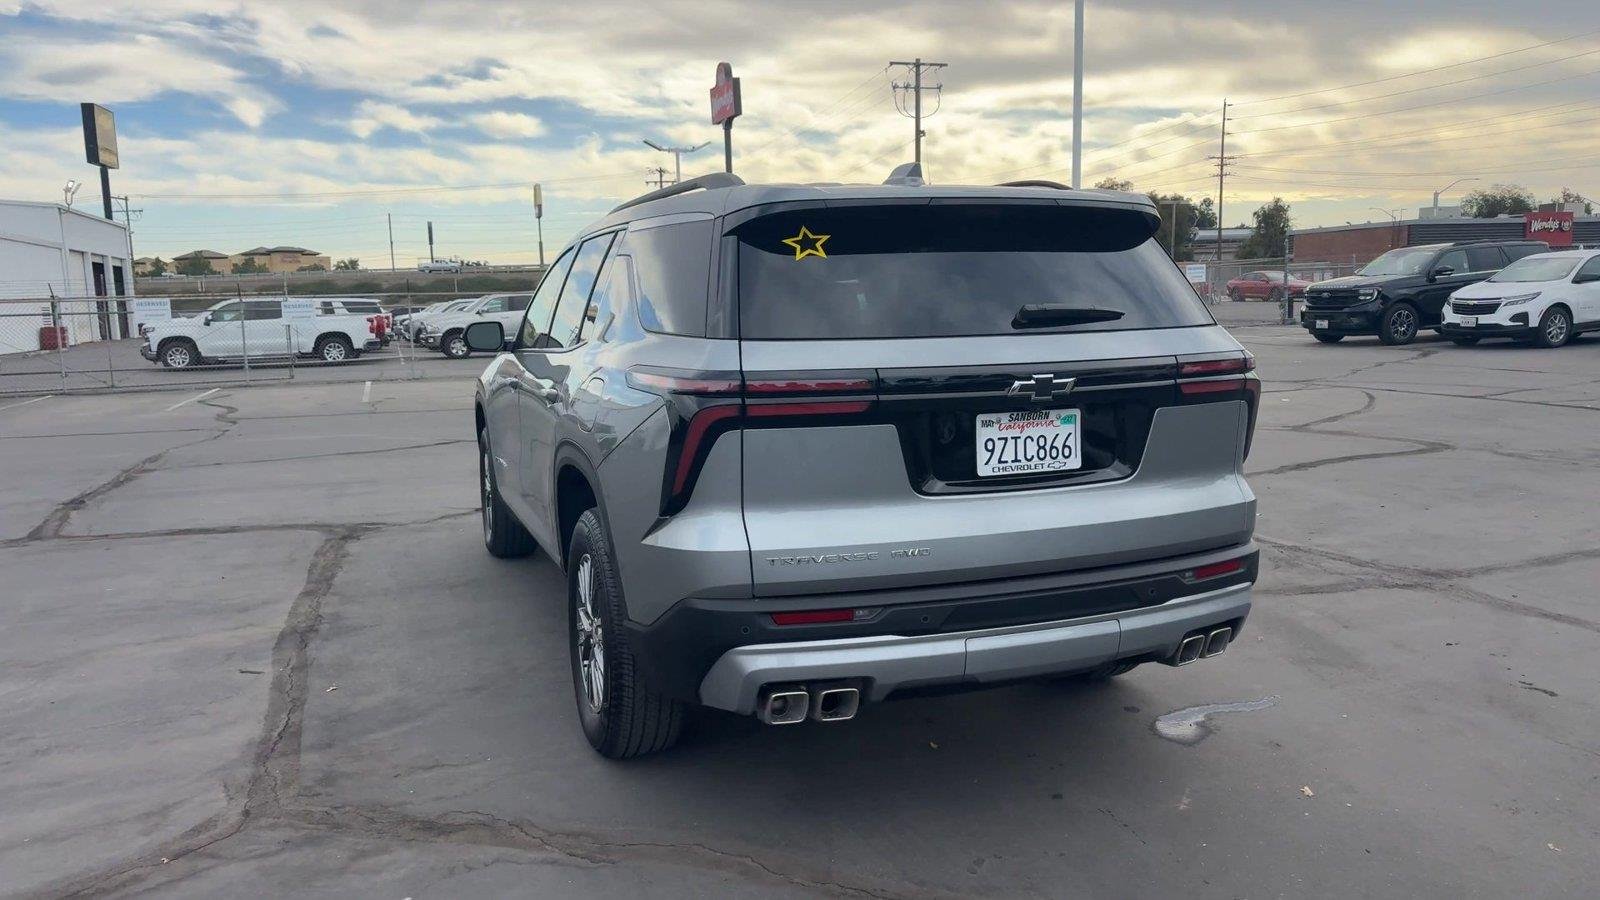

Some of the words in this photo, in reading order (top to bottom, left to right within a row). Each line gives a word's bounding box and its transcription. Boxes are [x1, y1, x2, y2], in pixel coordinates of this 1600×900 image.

[1531, 217, 1559, 232] Wendy's
[1008, 411, 1050, 422] SANBORN
[998, 419, 1060, 434] California
[983, 432, 1073, 466] 9ZIC866
[992, 462, 1046, 473] CHEVROLET
[766, 551, 879, 567] TRAVERSE
[891, 547, 932, 559] AWD
